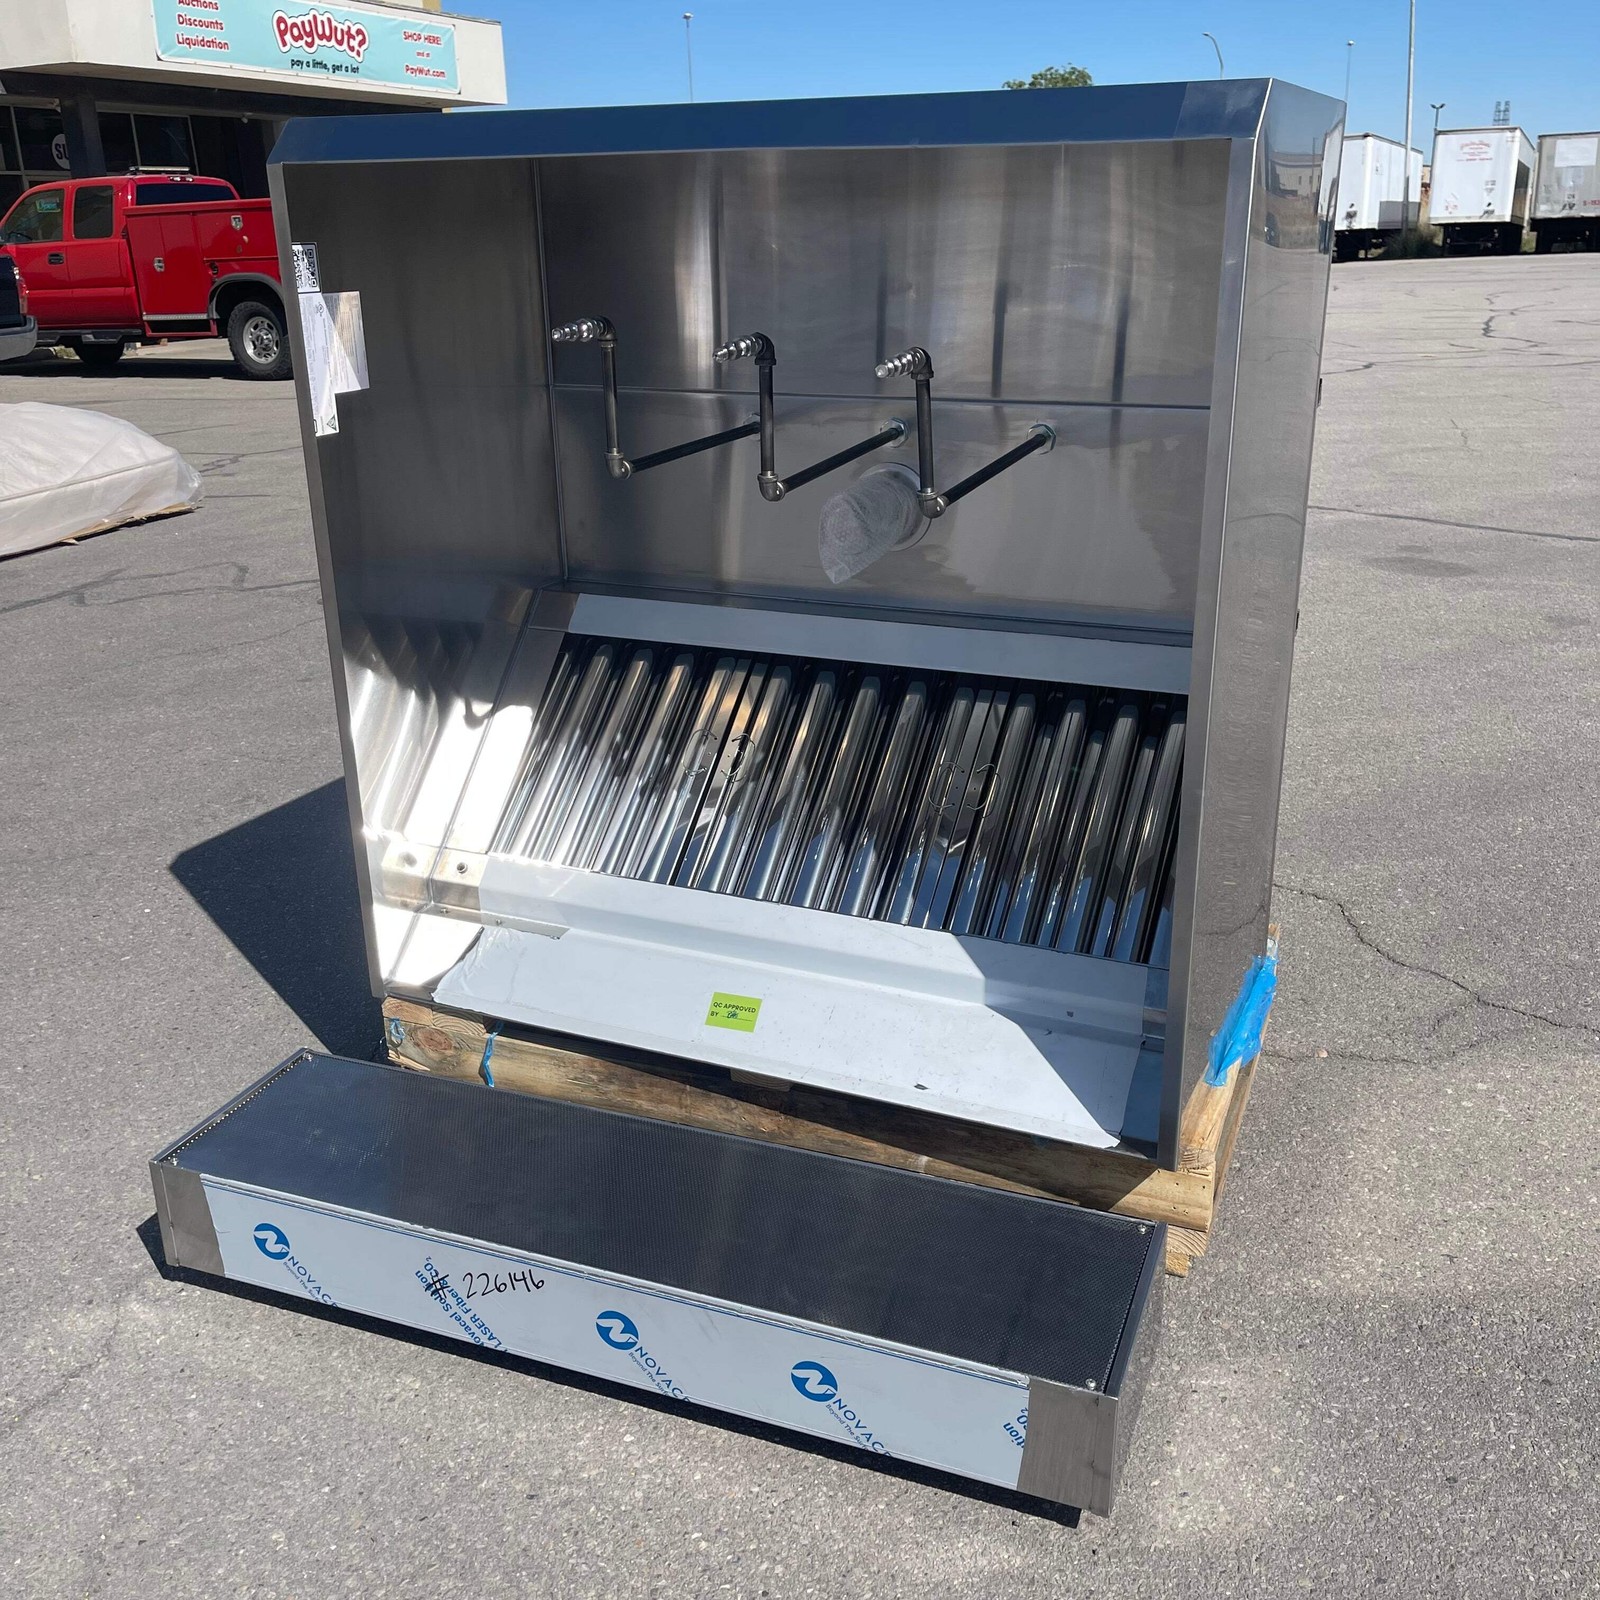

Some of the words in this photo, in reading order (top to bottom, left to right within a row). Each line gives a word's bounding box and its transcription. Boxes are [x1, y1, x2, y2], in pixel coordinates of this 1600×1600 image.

[177, 13, 224, 31] Discounts
[275, 13, 367, 58] PayWut?
[176, 33, 230, 51] Liquidation
[403, 31, 422, 42] SHOP
[290, 59, 305, 70] pay
[305, 60, 311, 68] a
[311, 59, 330, 72] little,
[331, 63, 343, 74] get
[344, 65, 350, 73] a
[350, 64, 360, 74] lot
[405, 64, 446, 78] PayWut.com
[723, 1003, 757, 1014] APPROVED
[282, 1261, 300, 1280] Beyond
[299, 1279, 308, 1290] The
[462, 1268, 545, 1299] 226146
[447, 1288, 472, 1315] Fiber
[470, 1313, 503, 1348] LASER
[628, 1351, 647, 1372] Beyond
[646, 1371, 656, 1383] The
[825, 1403, 845, 1425] Beyond
[844, 1424, 855, 1436] The
